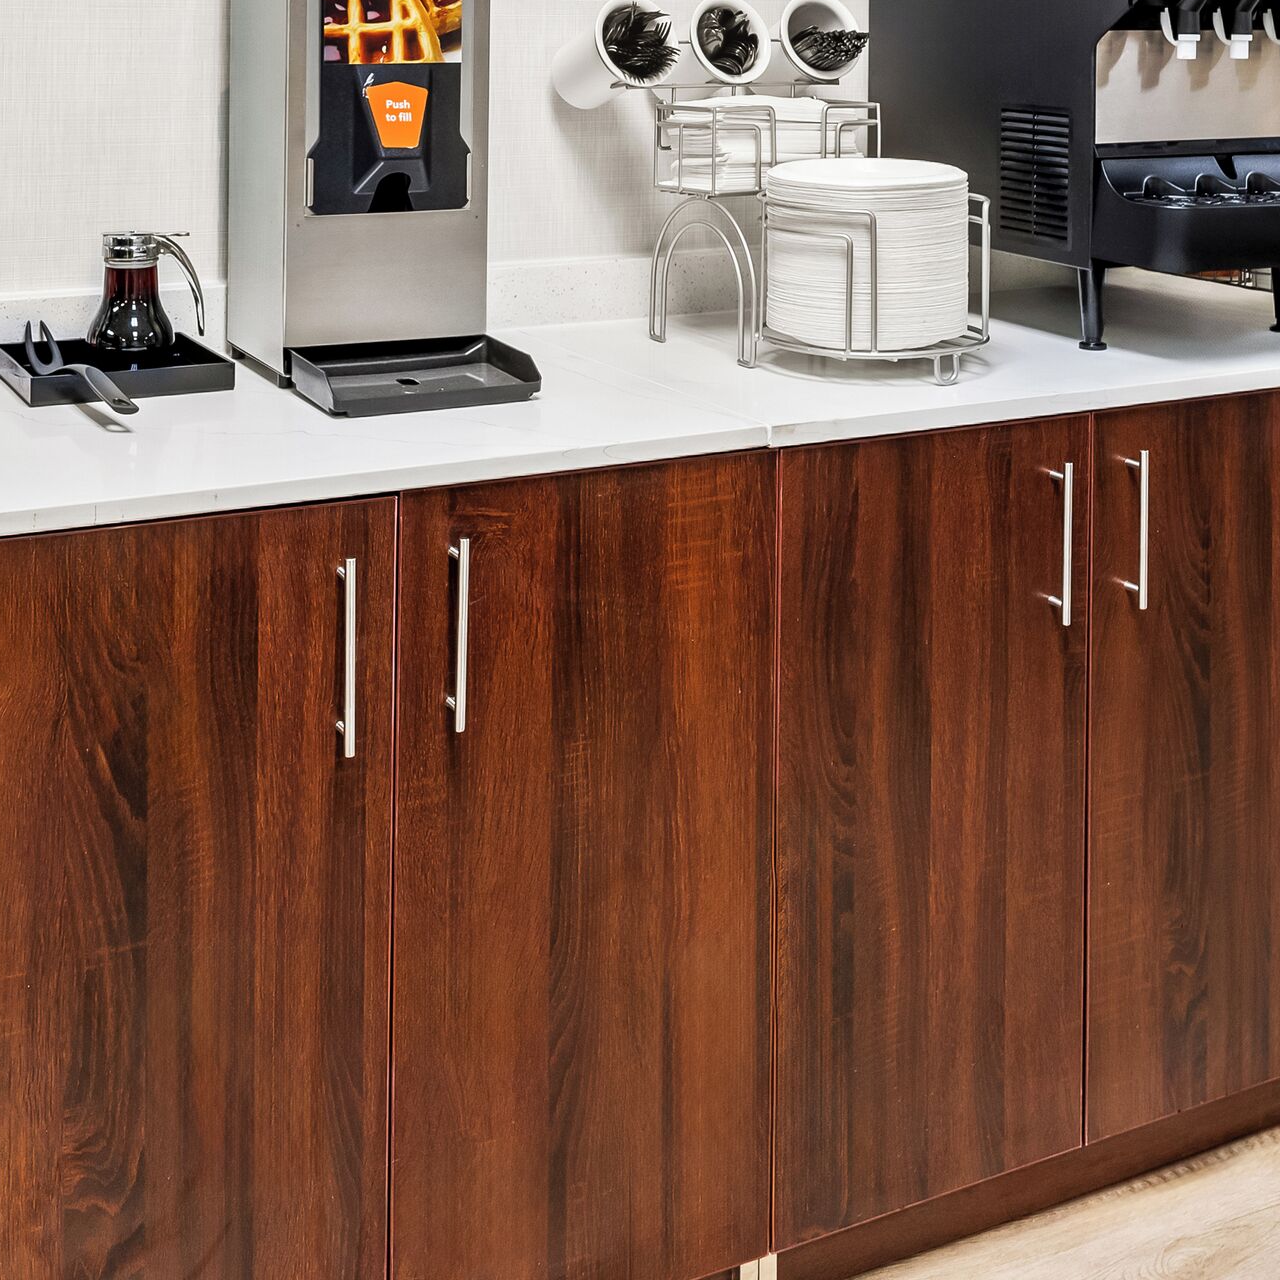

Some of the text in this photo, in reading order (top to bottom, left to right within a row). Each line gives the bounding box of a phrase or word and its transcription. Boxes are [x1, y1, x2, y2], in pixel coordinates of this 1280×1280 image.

[385, 99, 411, 109] Push
[385, 112, 412, 122] to fill
